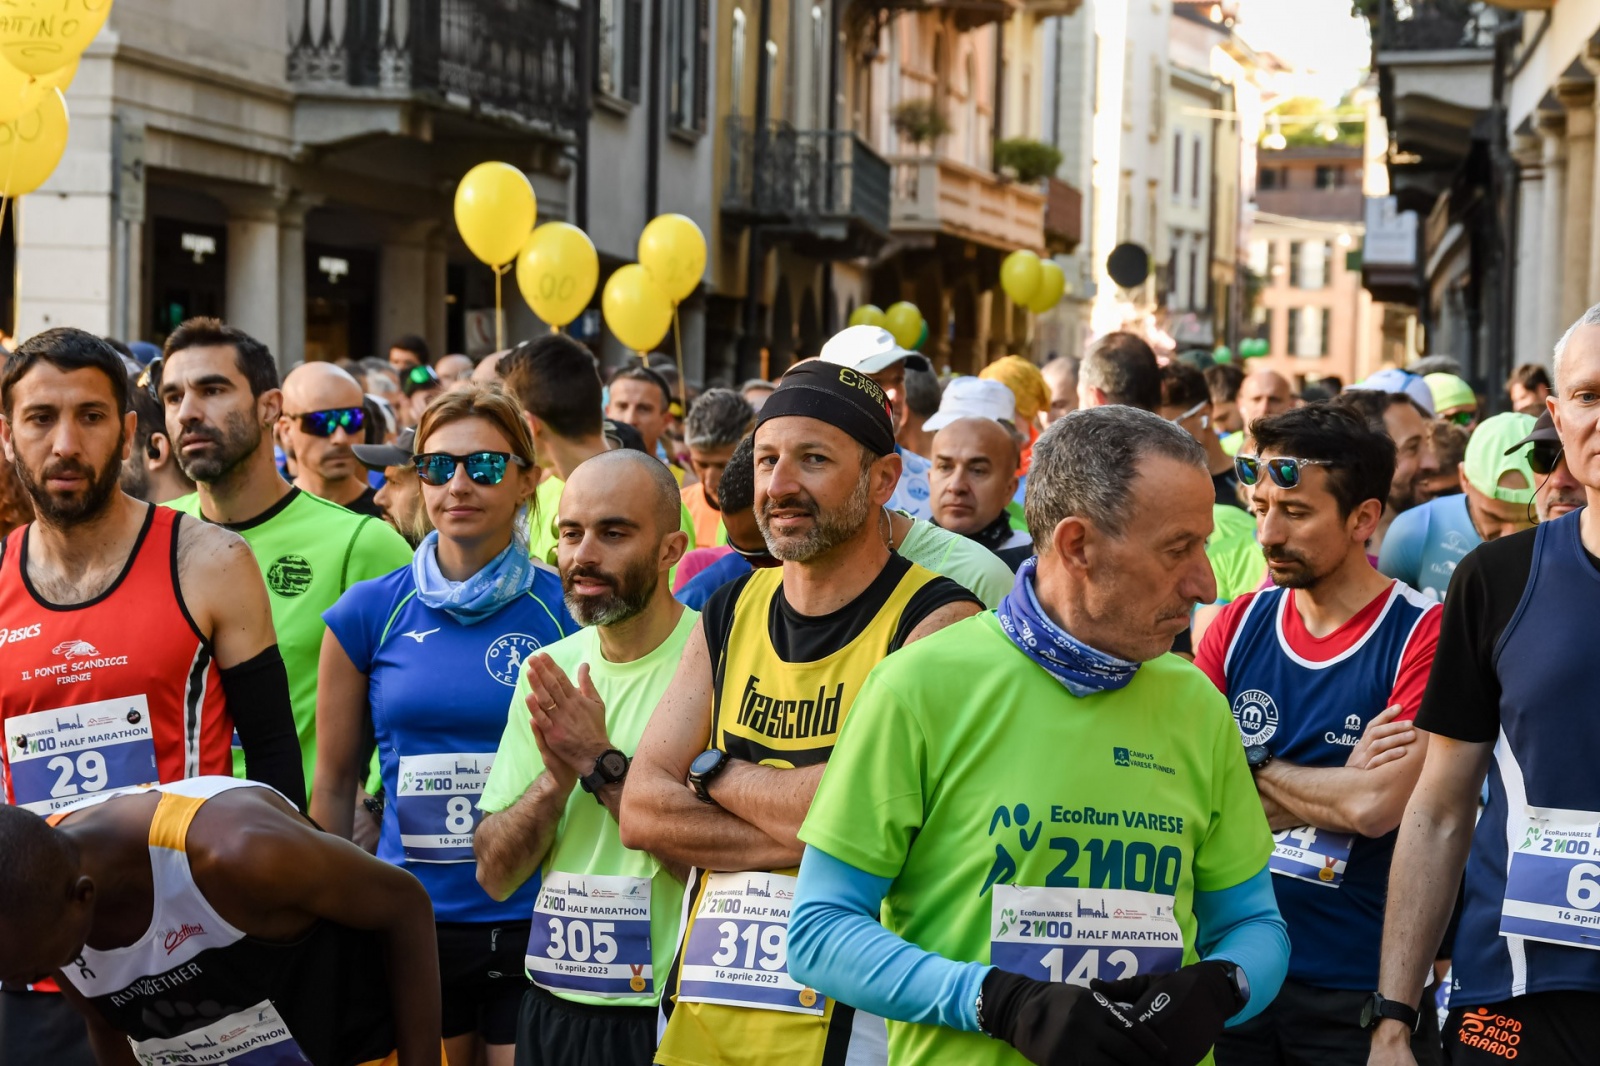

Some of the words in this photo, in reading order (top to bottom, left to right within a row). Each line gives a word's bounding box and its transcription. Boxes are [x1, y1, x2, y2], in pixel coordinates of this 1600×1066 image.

[8, 623, 41, 643] asics
[490, 637, 538, 658] ORTIC
[21, 671, 32, 681] IL
[34, 663, 67, 678] PONTE
[71, 656, 128, 672] SCANDICCI
[56, 672, 92, 685] FIRENZE
[736, 674, 845, 739] Frascold
[1242, 692, 1271, 708] ATLETICA
[1242, 720, 1260, 730] mico
[60, 738, 86, 748] HALF
[88, 727, 149, 744] MARATHON
[1129, 750, 1154, 760] CAMPUS
[46, 750, 108, 799] 29
[445, 796, 482, 834] 8
[1050, 805, 1119, 827] EcoRun
[1122, 810, 1184, 835] VARESE
[1544, 829, 1568, 837] EcoRun
[1282, 848, 1304, 859] 2023
[1566, 862, 1600, 910] 6
[567, 905, 589, 913] HALF
[590, 907, 647, 915] MARATHON
[743, 907, 768, 915] HALF
[1558, 910, 1571, 920] 16
[546, 917, 618, 964] 305
[1077, 930, 1109, 940] HALF
[1111, 930, 1179, 941] MARATHON
[712, 921, 787, 971] 319
[554, 962, 564, 970] 16
[565, 963, 587, 973] aprile
[588, 966, 608, 974] 2023
[715, 970, 725, 978] 16
[727, 972, 753, 981] aprile
[755, 974, 779, 983] 2023
[1496, 1015, 1522, 1032] GPD
[199, 1050, 225, 1062] HALF
[228, 1027, 286, 1054] MARATHON
[1484, 1025, 1520, 1046] ALDO
